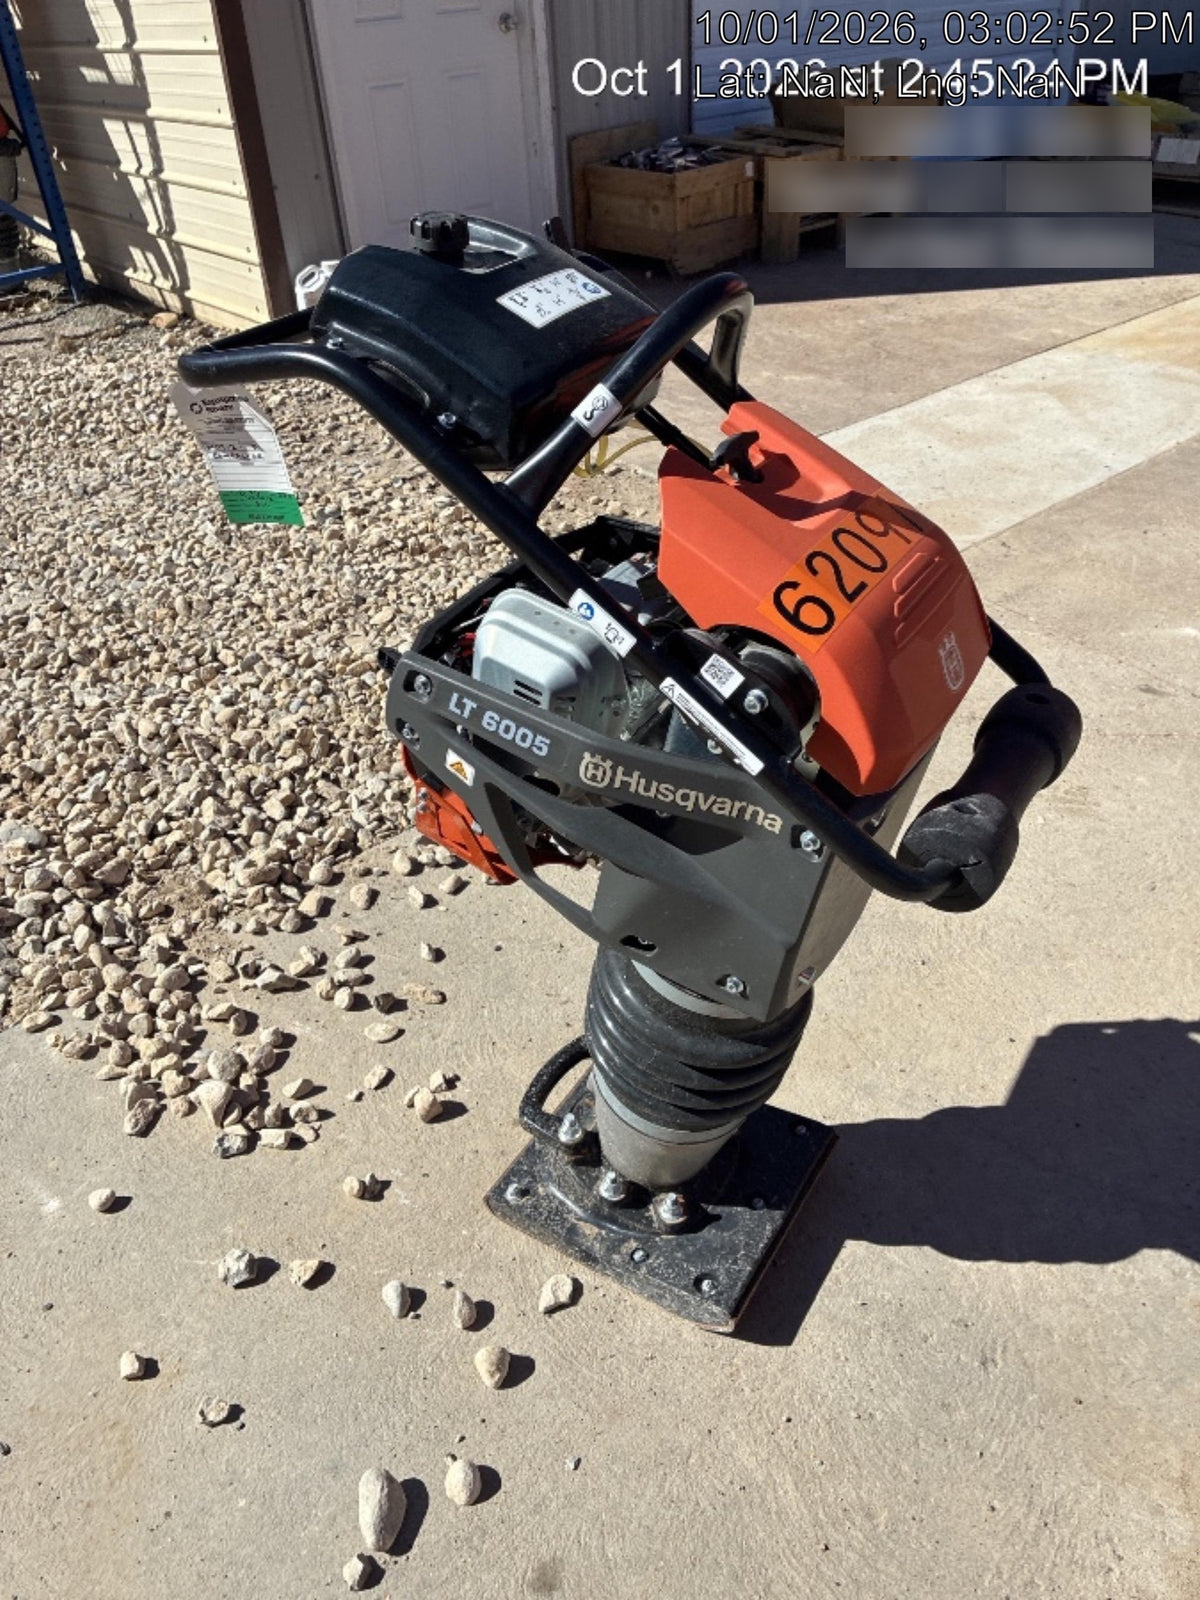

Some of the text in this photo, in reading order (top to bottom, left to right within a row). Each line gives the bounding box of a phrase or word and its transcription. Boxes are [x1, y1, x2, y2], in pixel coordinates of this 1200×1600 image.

[448, 692, 551, 757] LT 6005
[614, 765, 784, 834] Husqvarna
